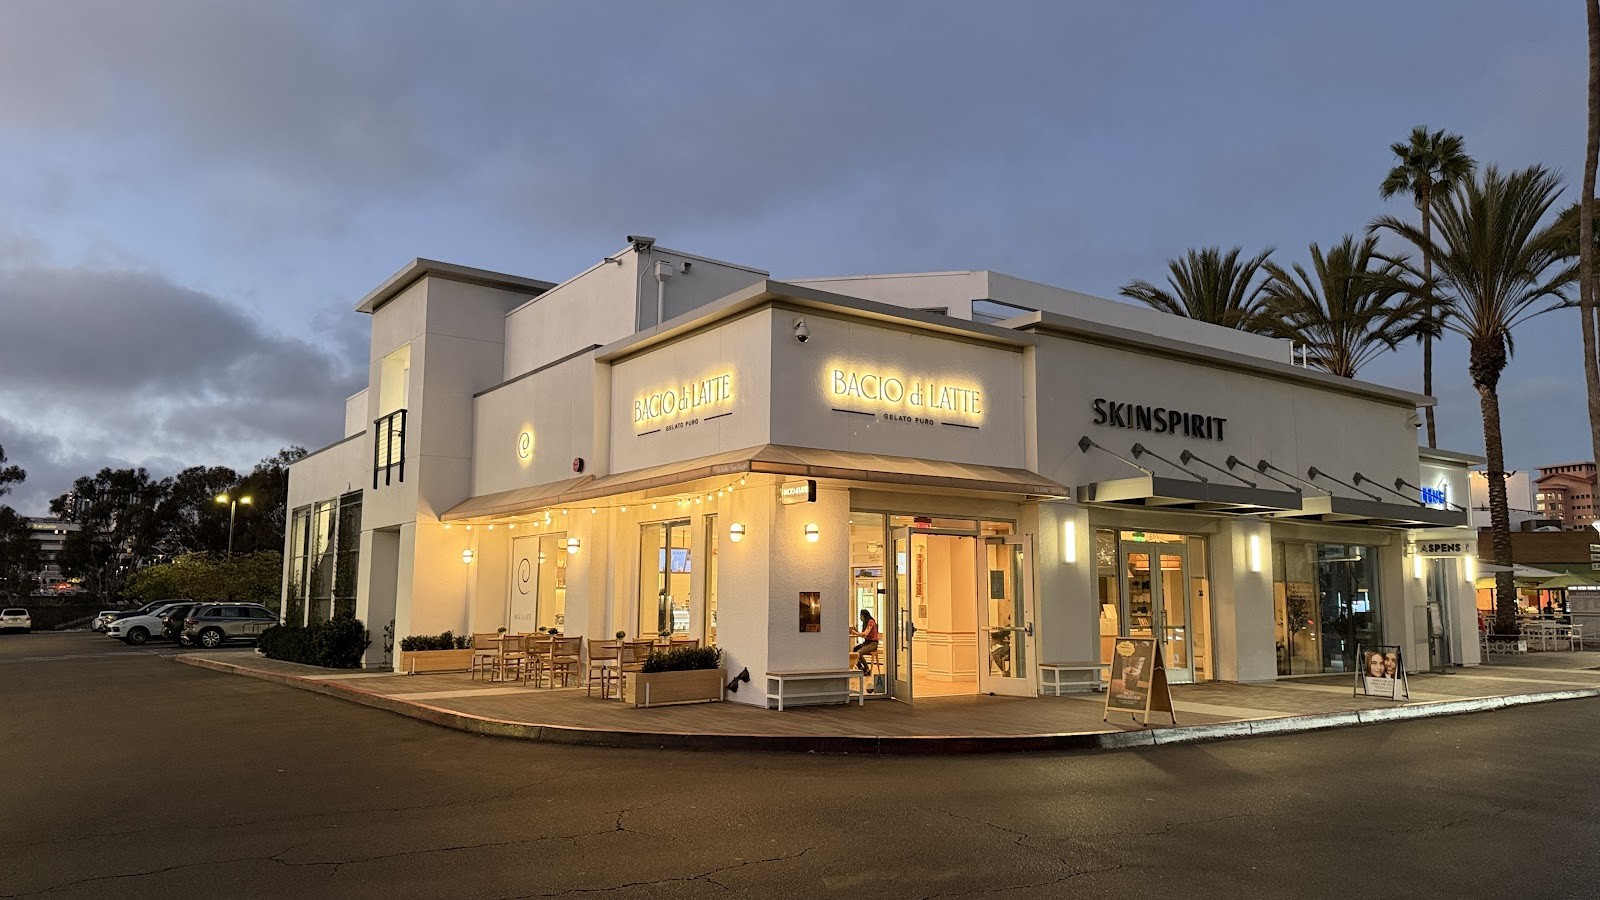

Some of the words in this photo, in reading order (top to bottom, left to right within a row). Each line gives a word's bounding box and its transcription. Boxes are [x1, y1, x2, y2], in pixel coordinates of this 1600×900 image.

[634, 390, 676, 422] BACIO
[678, 387, 688, 411] di
[692, 374, 730, 408] LATTE
[834, 369, 904, 403] BACIO
[910, 383, 924, 406] di
[930, 384, 982, 414] LATTE
[665, 422, 684, 432] GELATO
[685, 418, 699, 427] PURO
[883, 413, 912, 423] GELATO
[915, 417, 934, 426] PURO
[1092, 398, 1228, 442] SKINSPIRIT
[1420, 543, 1462, 553] ASPENS
